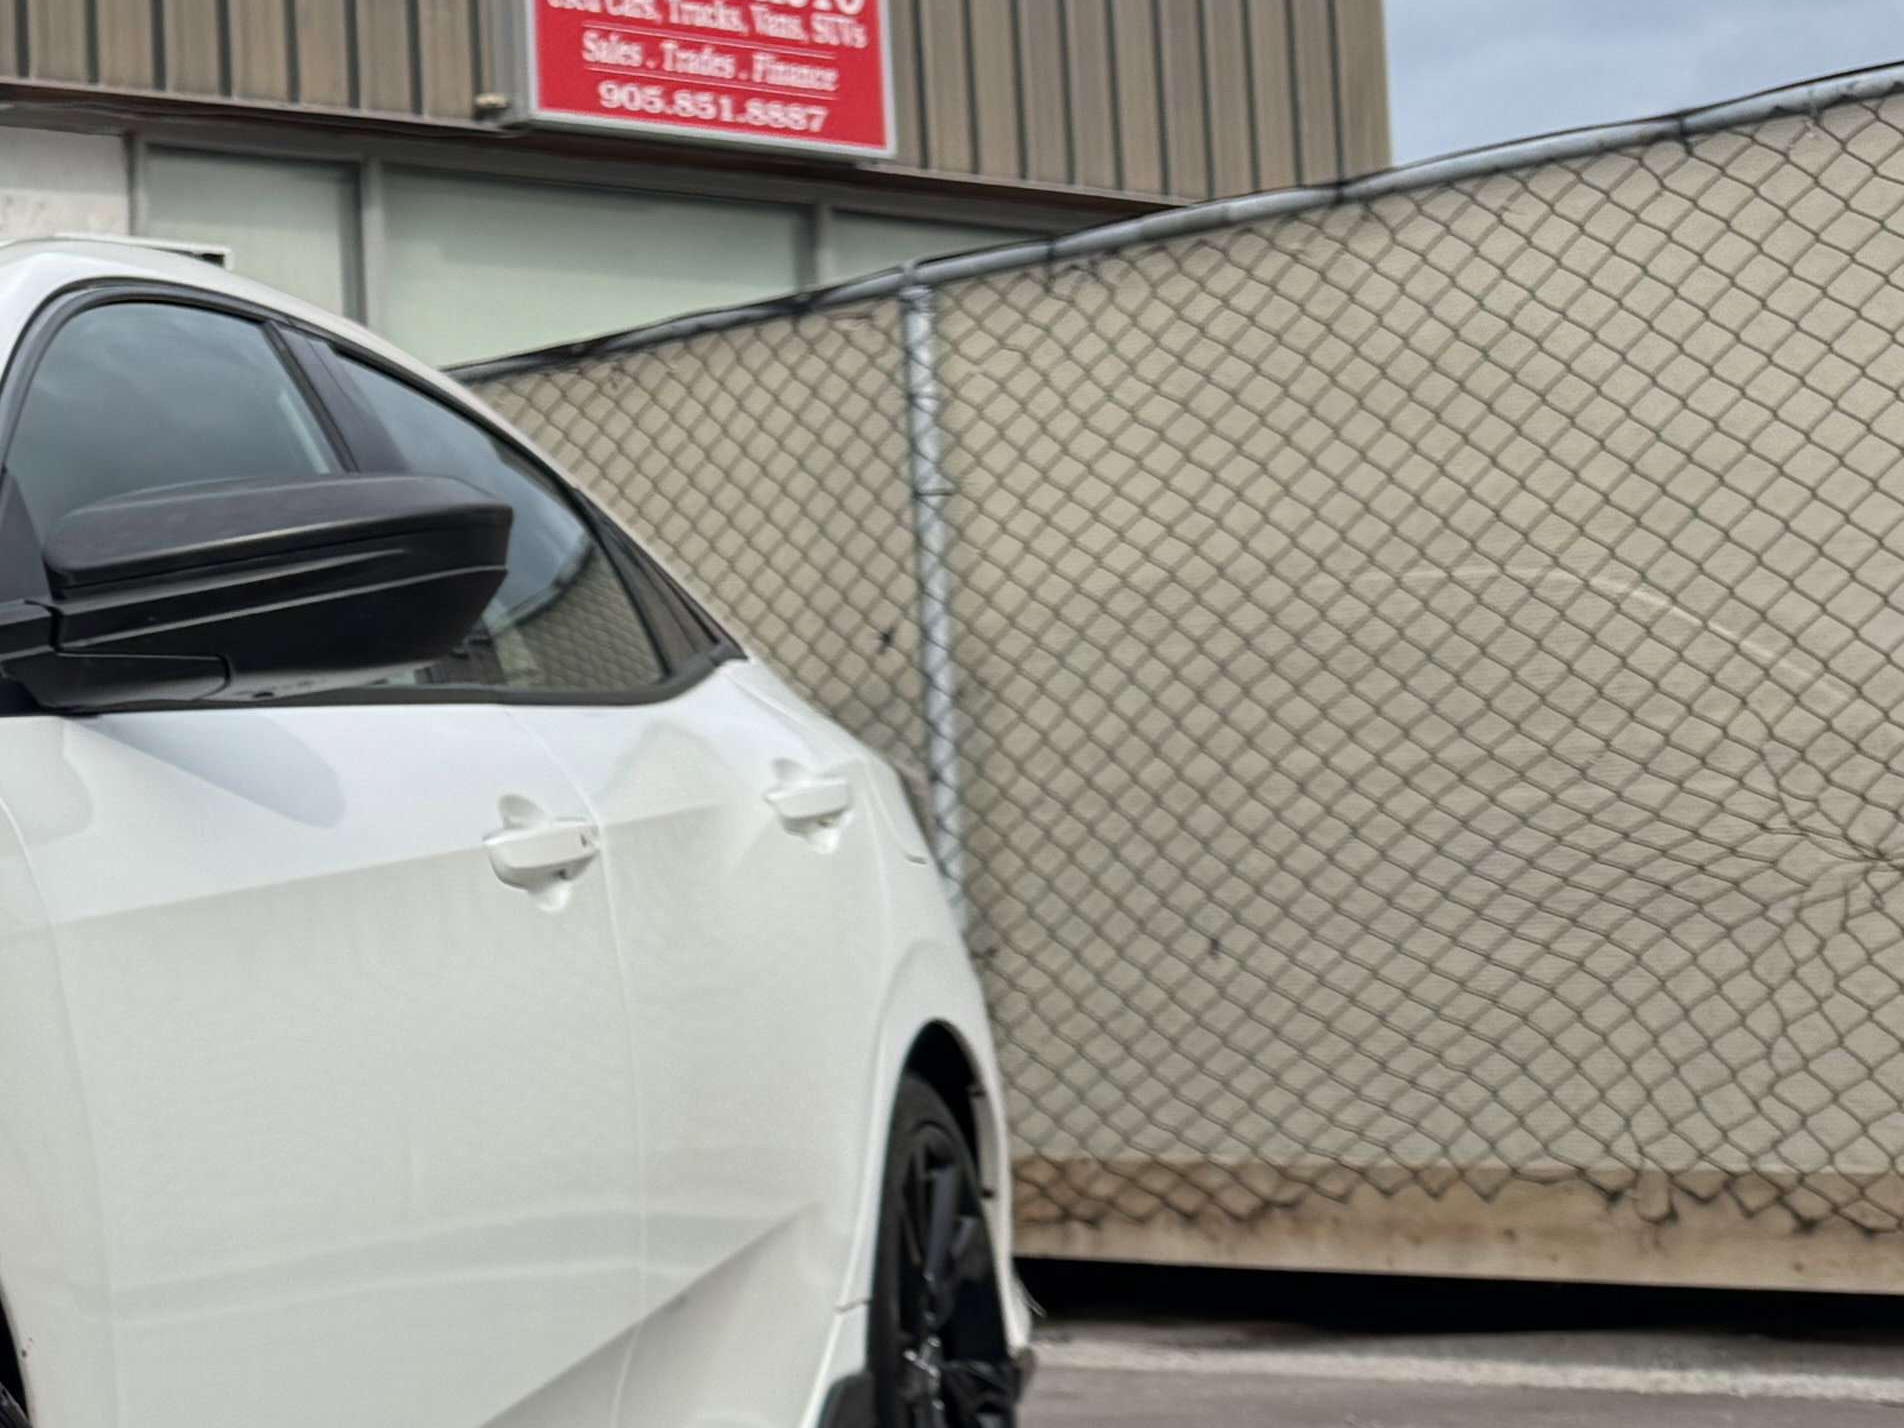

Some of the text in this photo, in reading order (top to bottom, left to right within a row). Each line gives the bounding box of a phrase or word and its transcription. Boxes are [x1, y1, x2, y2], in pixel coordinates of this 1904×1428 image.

[811, 13, 868, 50] SUVs
[581, 30, 840, 93] Sales Trades Finance
[597, 79, 829, 134] 905.851.8887
